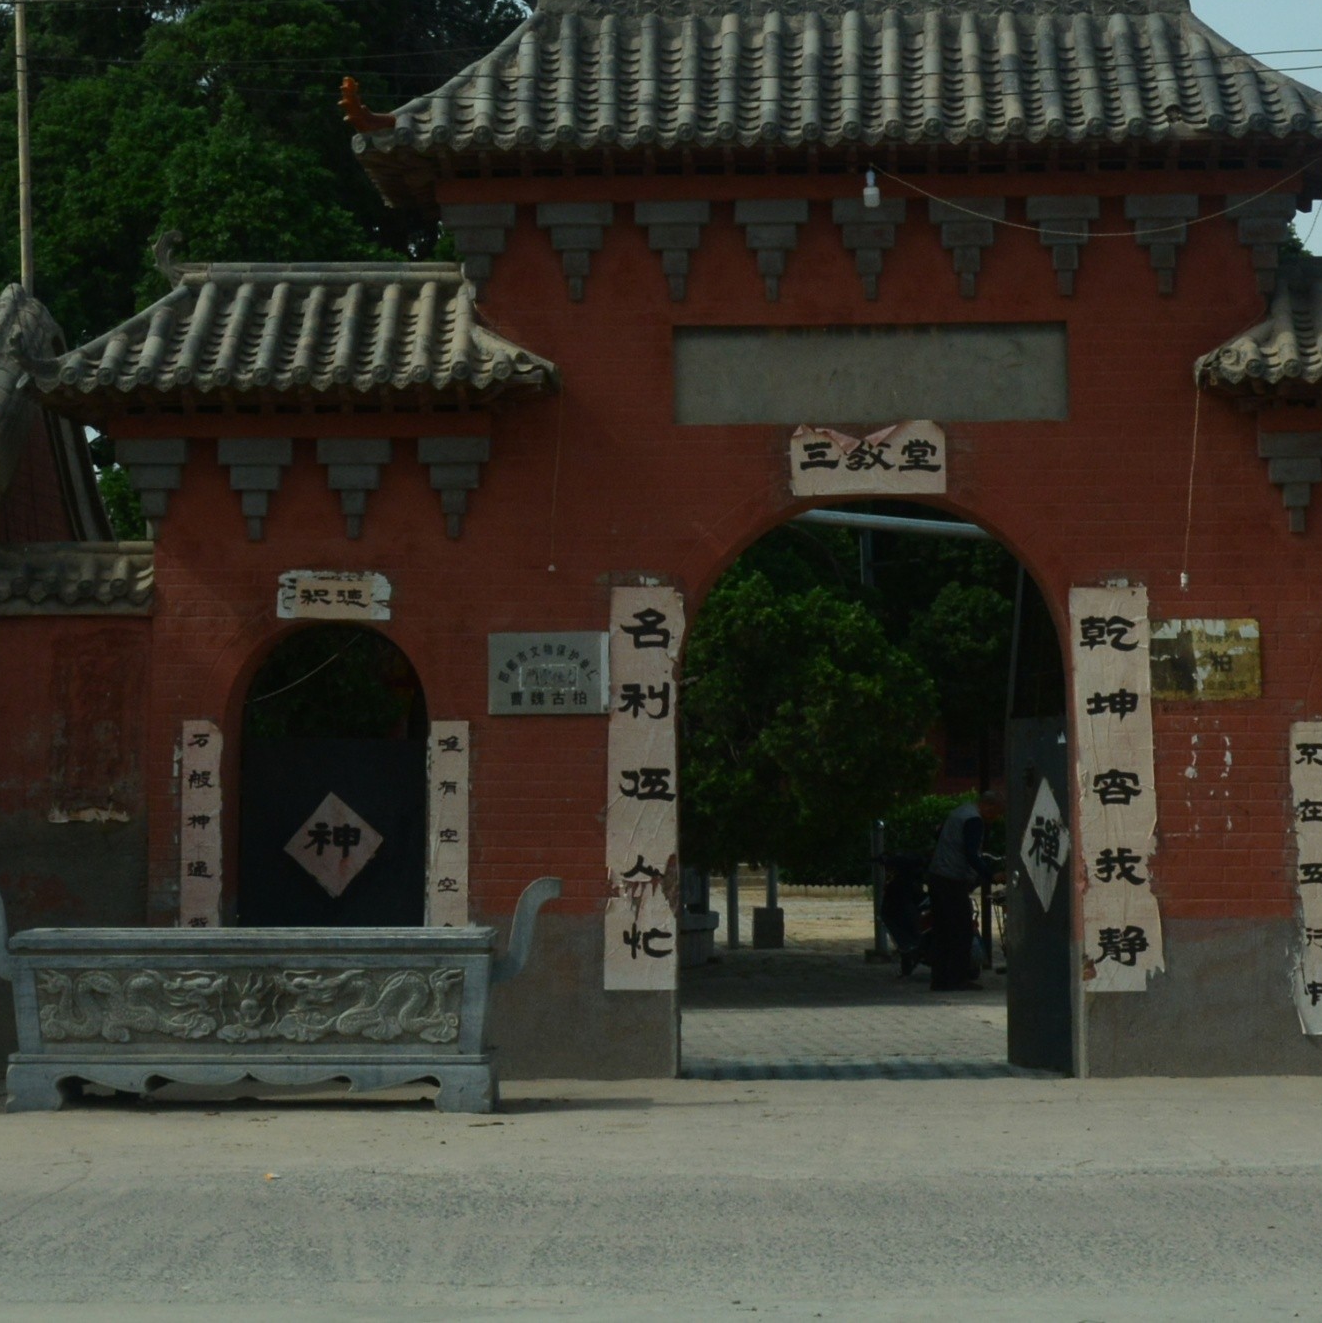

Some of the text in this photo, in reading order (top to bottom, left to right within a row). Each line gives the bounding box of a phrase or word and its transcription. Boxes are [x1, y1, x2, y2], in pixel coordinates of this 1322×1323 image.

[510, 691, 588, 706] 曹魏古柏
[306, 820, 359, 859] 神
